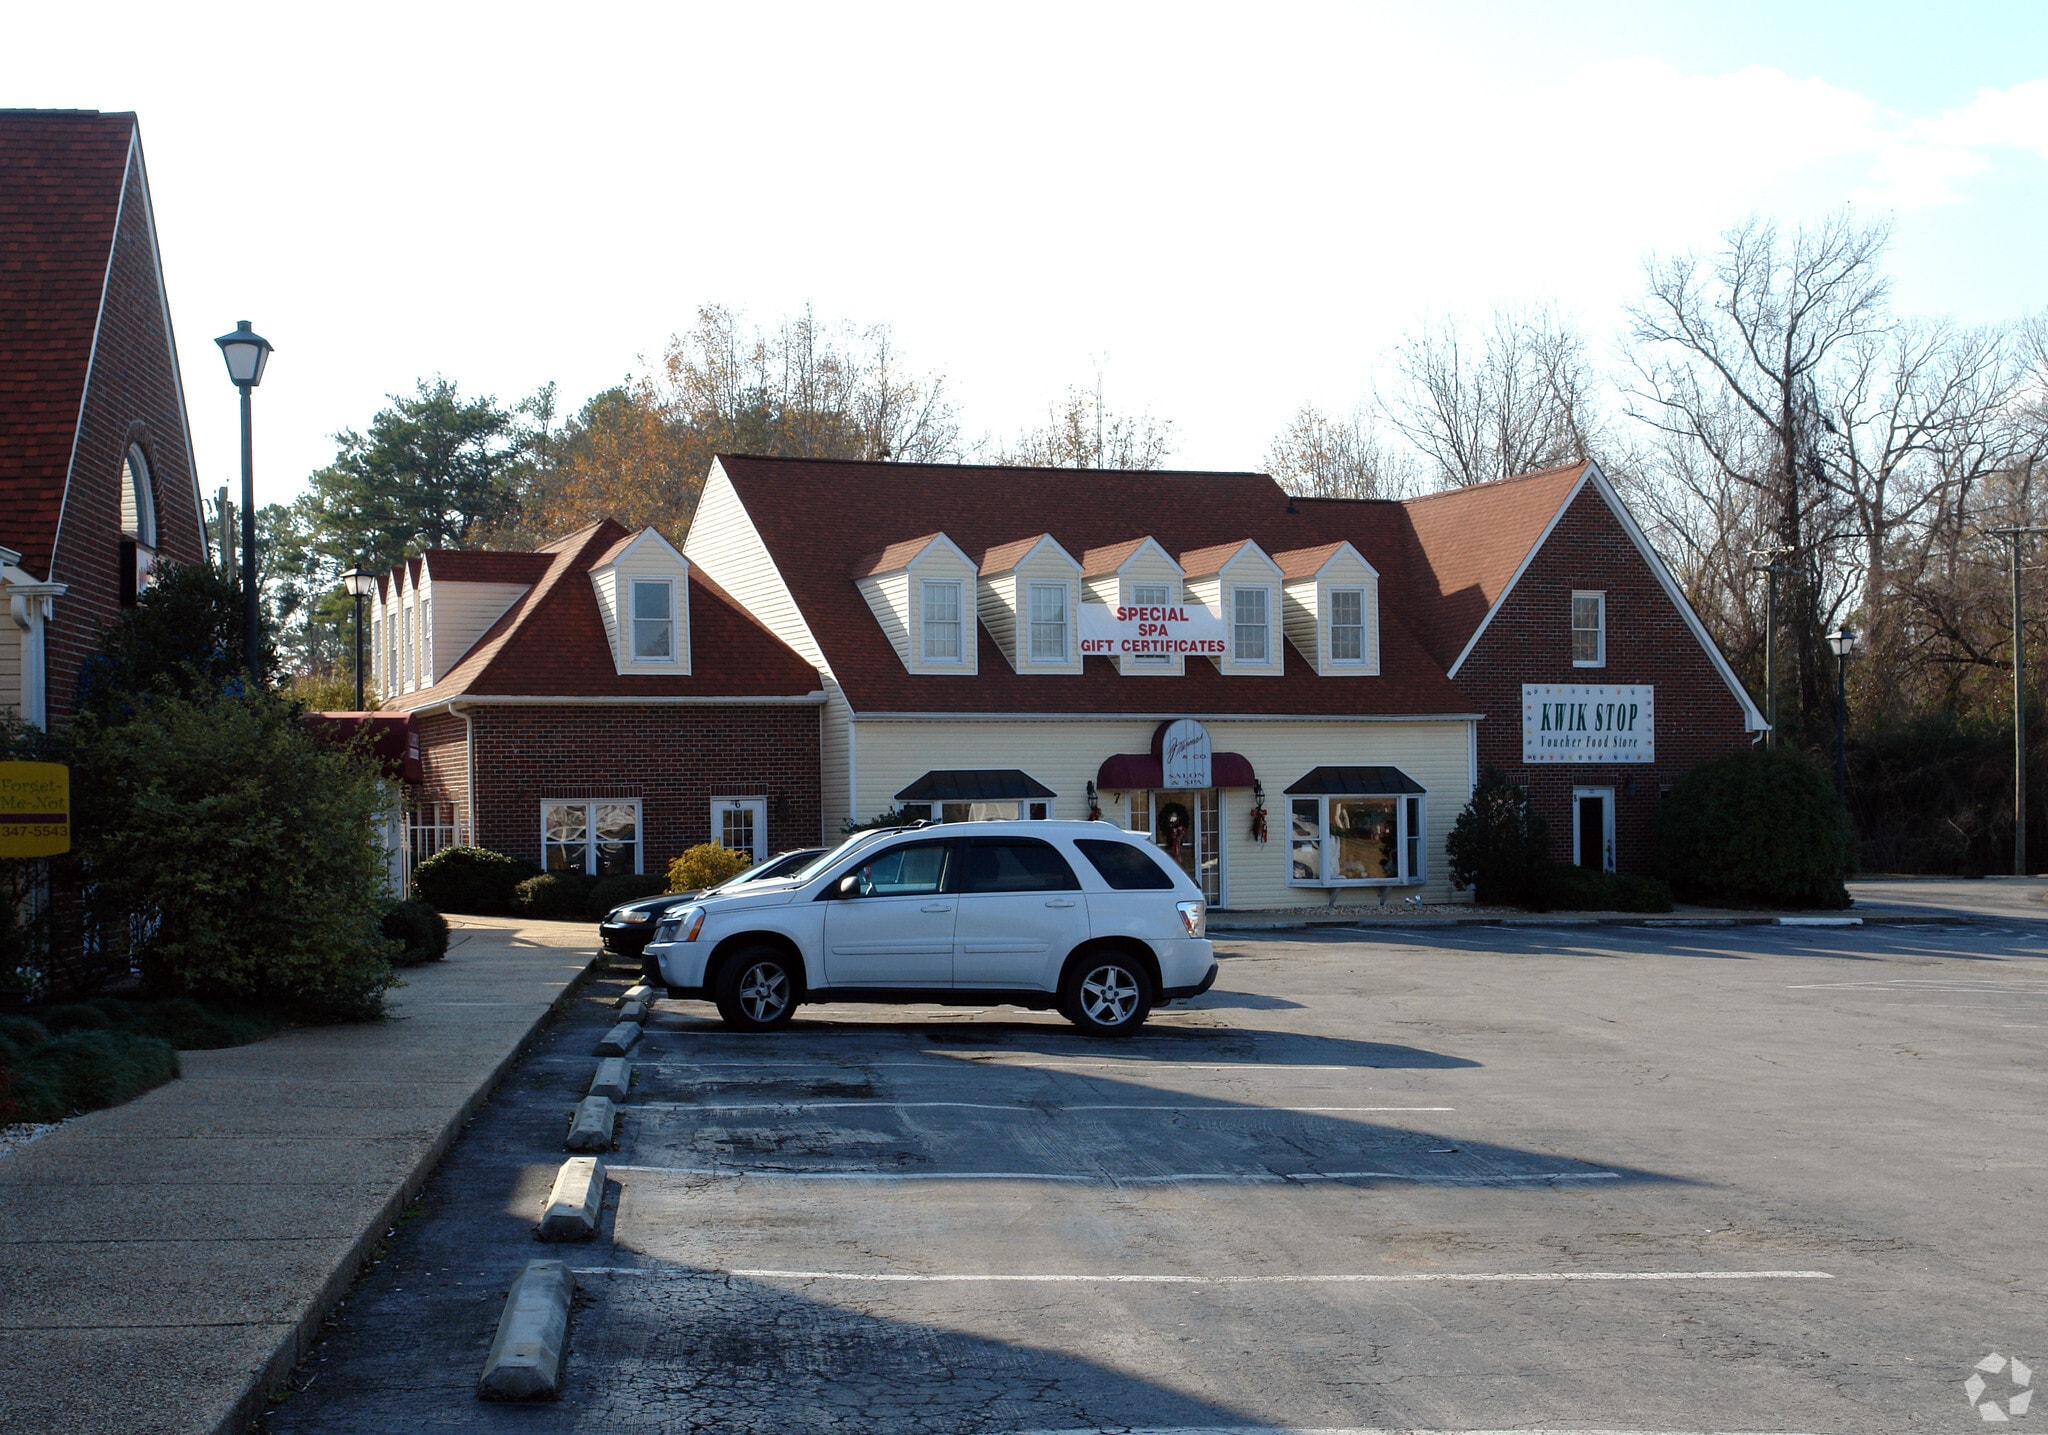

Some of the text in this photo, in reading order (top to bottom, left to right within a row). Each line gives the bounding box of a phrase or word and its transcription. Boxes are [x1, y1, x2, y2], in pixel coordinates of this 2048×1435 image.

[1116, 607, 1189, 622] SPECIAL
[1138, 623, 1169, 637] SPA
[1080, 639, 1226, 653] GIFT CERTIFICATES
[1540, 703, 1638, 731] KWIK STOP
[1540, 735, 1638, 748] Voucher Food Store
[1, 778, 62, 796] Forget-
[0, 795, 66, 810] Me-Not
[735, 800, 741, 808] 6
[1114, 793, 1121, 804] 7
[1, 826, 68, 837] 347-5543
